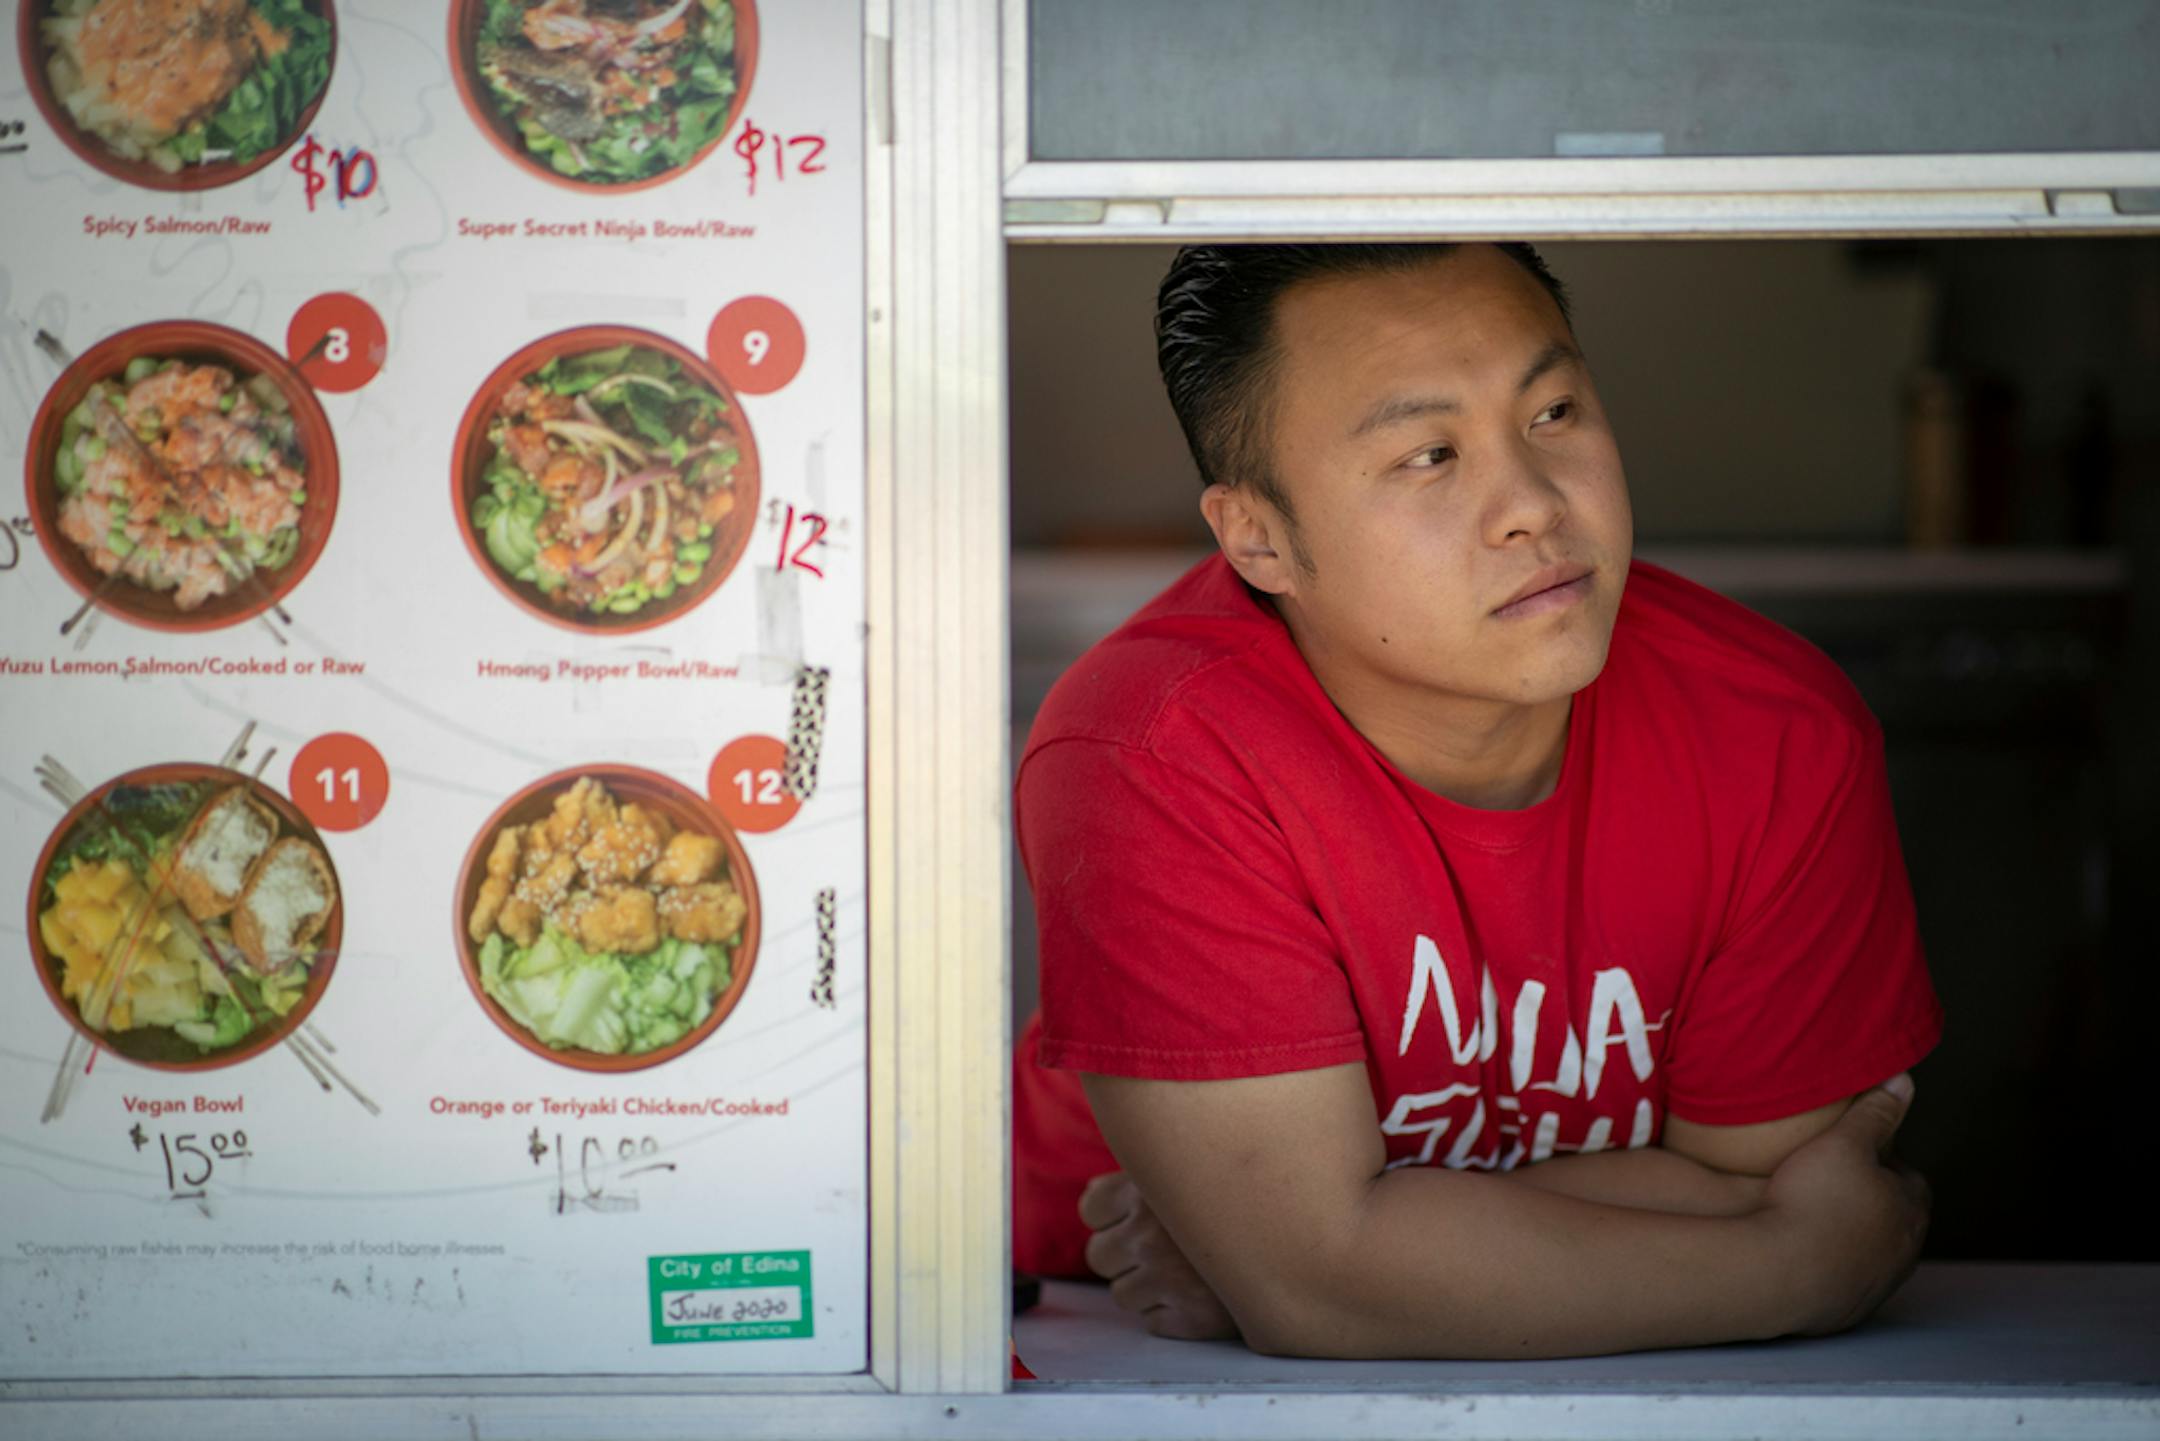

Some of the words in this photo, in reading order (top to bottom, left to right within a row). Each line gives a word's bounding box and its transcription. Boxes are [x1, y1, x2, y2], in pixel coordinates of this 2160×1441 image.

[734, 118, 827, 196] $12
[291, 133, 378, 212] $10
[83, 216, 136, 238] Spicy
[144, 215, 271, 235] Salmon/Raw
[458, 218, 516, 239] Super
[524, 218, 587, 237] Secret
[595, 219, 646, 241] Ninja
[654, 220, 756, 238] Bowl/Raw
[324, 328, 349, 362] 8
[743, 330, 769, 365] 9
[0, 657, 43, 675] Yuzu
[51, 657, 117, 675] Lemon
[125, 656, 286, 676] Salmon/Cooked
[294, 661, 313, 675] or
[322, 658, 366, 675] Raw
[478, 660, 550, 681] Hmong
[557, 661, 630, 682] Pepper
[638, 661, 739, 679] Bowl/Raw
[315, 767, 361, 802] 11
[733, 769, 783, 804] 12
[122, 1096, 186, 1118] Vegan
[194, 1096, 244, 1113] Bowl
[430, 1097, 505, 1119] Orange
[512, 1101, 532, 1115] or
[541, 1098, 616, 1119] Teriyaki
[624, 1098, 788, 1117] Chicken/Cooked
[111, 1245, 136, 1256] raw
[141, 1240, 182, 1256] fishes
[186, 1245, 216, 1259] may
[220, 1241, 280, 1256] increase
[284, 1240, 307, 1255] the
[311, 1240, 337, 1255] risk
[340, 1240, 355, 1255] of
[359, 1240, 394, 1255] food
[659, 1258, 702, 1279] City
[710, 1257, 732, 1275] of
[741, 1255, 800, 1275] Edina
[732, 1298, 788, 1321] 2020
[673, 1328, 701, 1339] FIRE
[708, 1324, 792, 1337] PREVENTION
